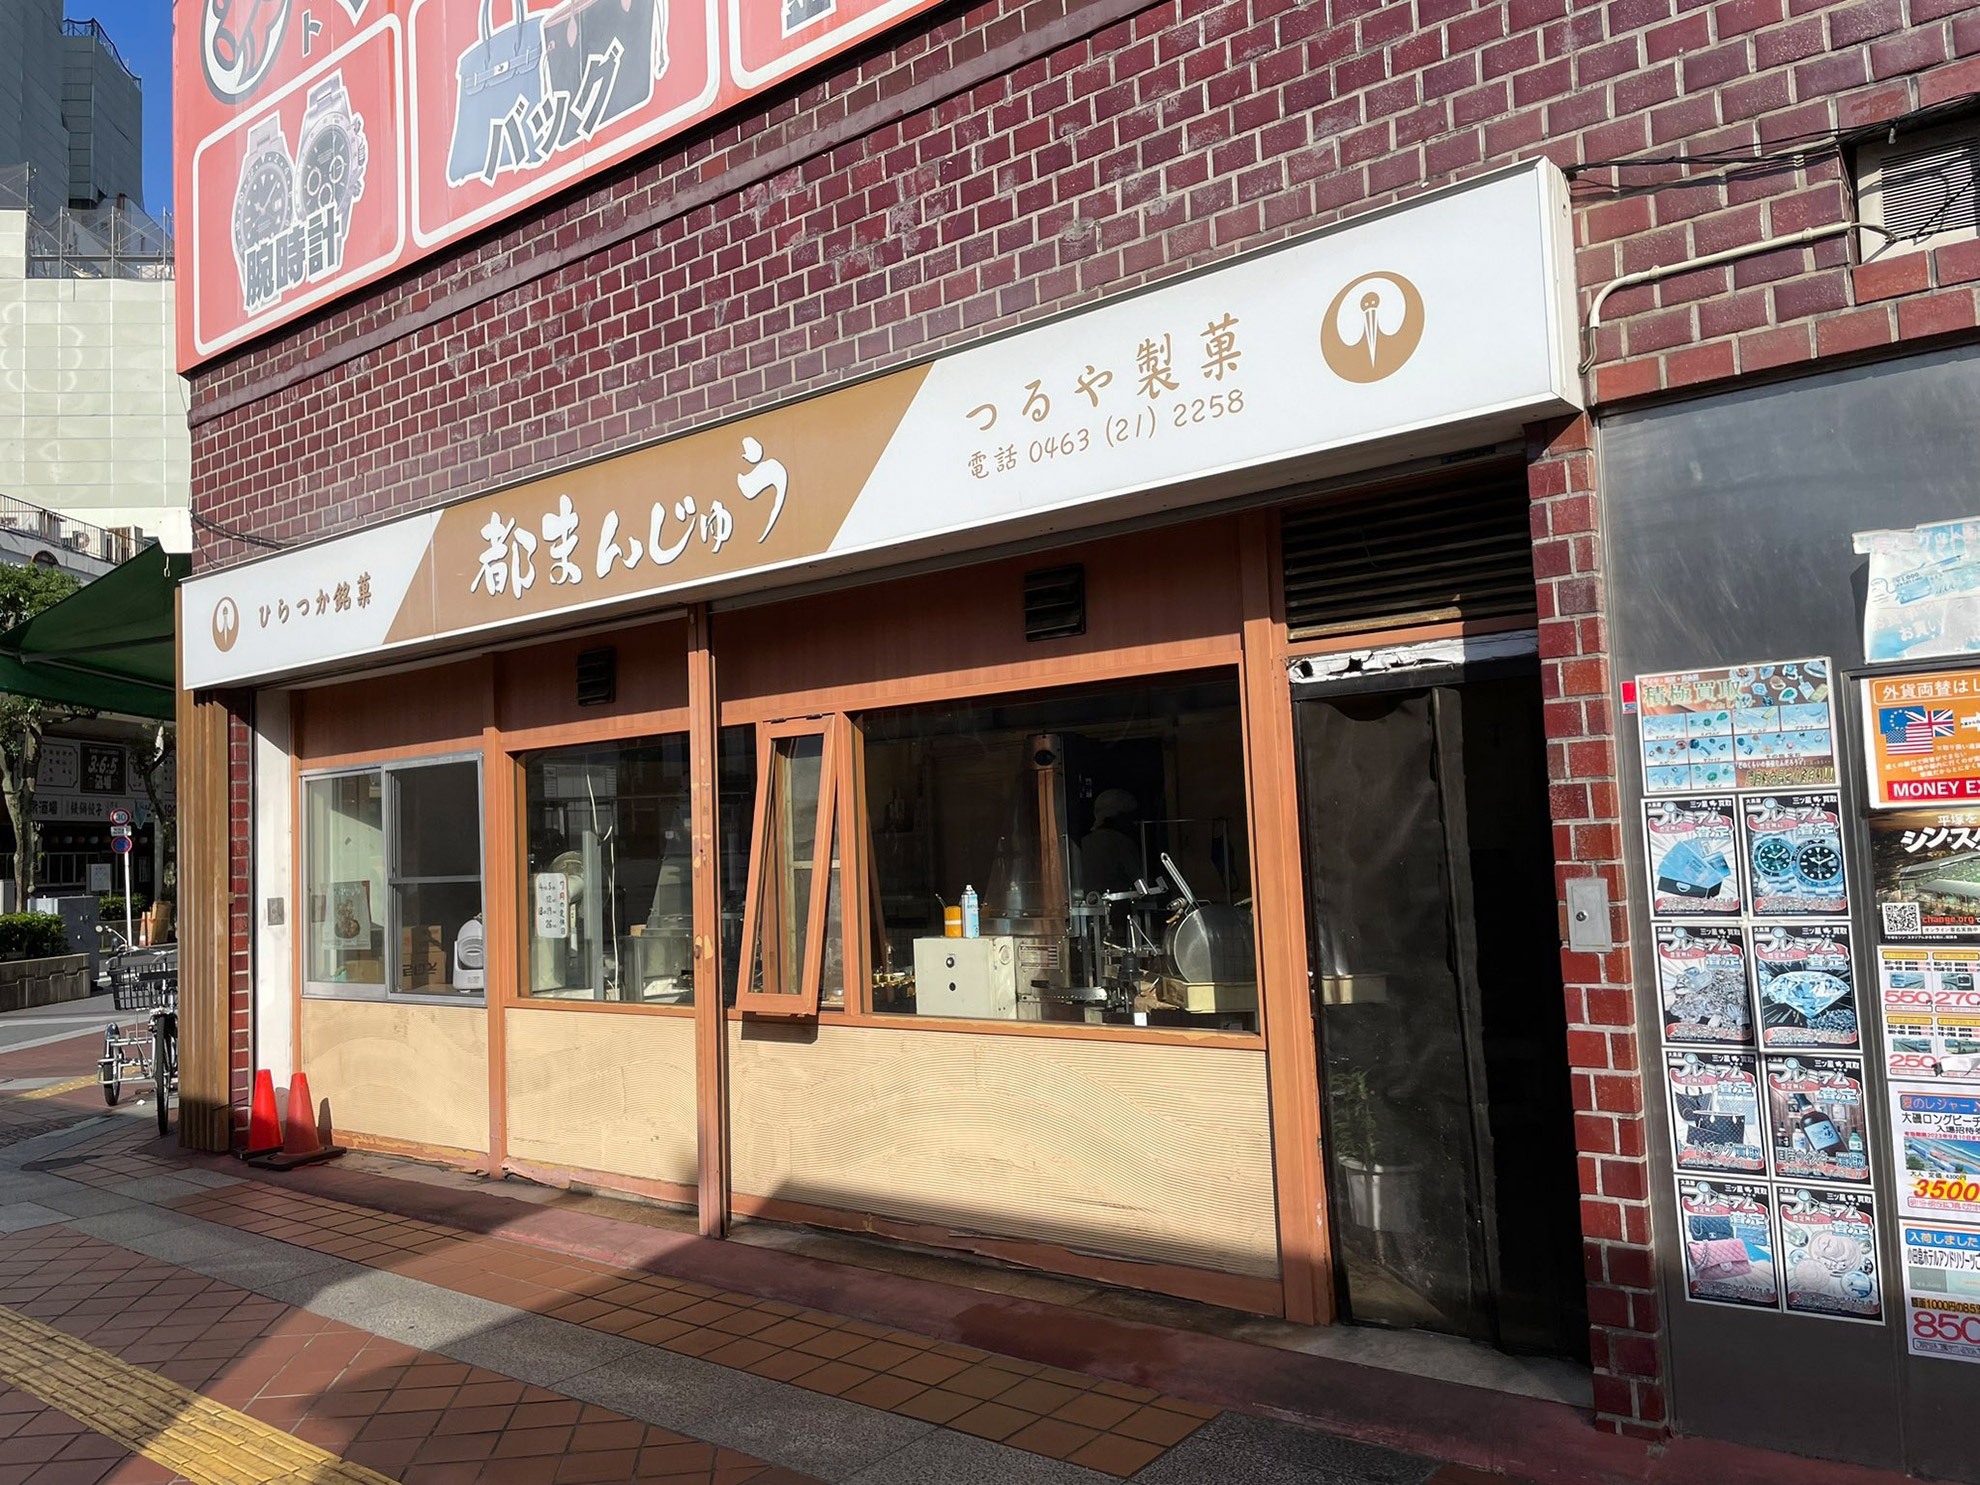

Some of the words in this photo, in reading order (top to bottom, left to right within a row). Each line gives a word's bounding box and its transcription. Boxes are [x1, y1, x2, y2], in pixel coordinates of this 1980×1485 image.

[482, 38, 624, 186] バッグ
[244, 203, 342, 310] 腕時計
[965, 312, 1243, 432] つるや製菓
[967, 445, 1018, 480] 電話
[1029, 427, 1090, 464] 0463
[1106, 404, 1157, 448] (21)
[1173, 388, 1245, 428] 2258
[470, 436, 789, 600] 都まんじゅう
[258, 571, 372, 629] ひらつか銘菓
[1893, 781, 1960, 797] MONEY
[116, 813, 126, 821] 30
[1647, 803, 1723, 827] プレミアム
[1746, 798, 1828, 824] プレミアム
[1938, 813, 1978, 826] 平塚を
[1695, 826, 1730, 840] 査定
[1798, 822, 1834, 836] 査定
[1658, 927, 1733, 952] プレミアム
[1754, 927, 1838, 953] プレミアム
[1706, 954, 1741, 969] 査定
[1807, 953, 1845, 970] 査定
[1884, 990, 1933, 1005] 550
[1935, 991, 1980, 1006] 270
[1668, 1053, 1746, 1079] プレミアム
[1768, 1057, 1850, 1086] プレミアム
[1889, 1054, 1937, 1069] 250
[1717, 1081, 1754, 1097] 査定
[1819, 1087, 1858, 1104] 査定
[1681, 1181, 1758, 1211] プレミアム
[1914, 1179, 1980, 1203] 3500
[1779, 1189, 1863, 1220] プレミアム
[1730, 1211, 1767, 1228] 査定
[1832, 1220, 1871, 1238] 査定
[1910, 1231, 1980, 1248] 入荷しました
[1913, 1311, 1980, 1344] 850
